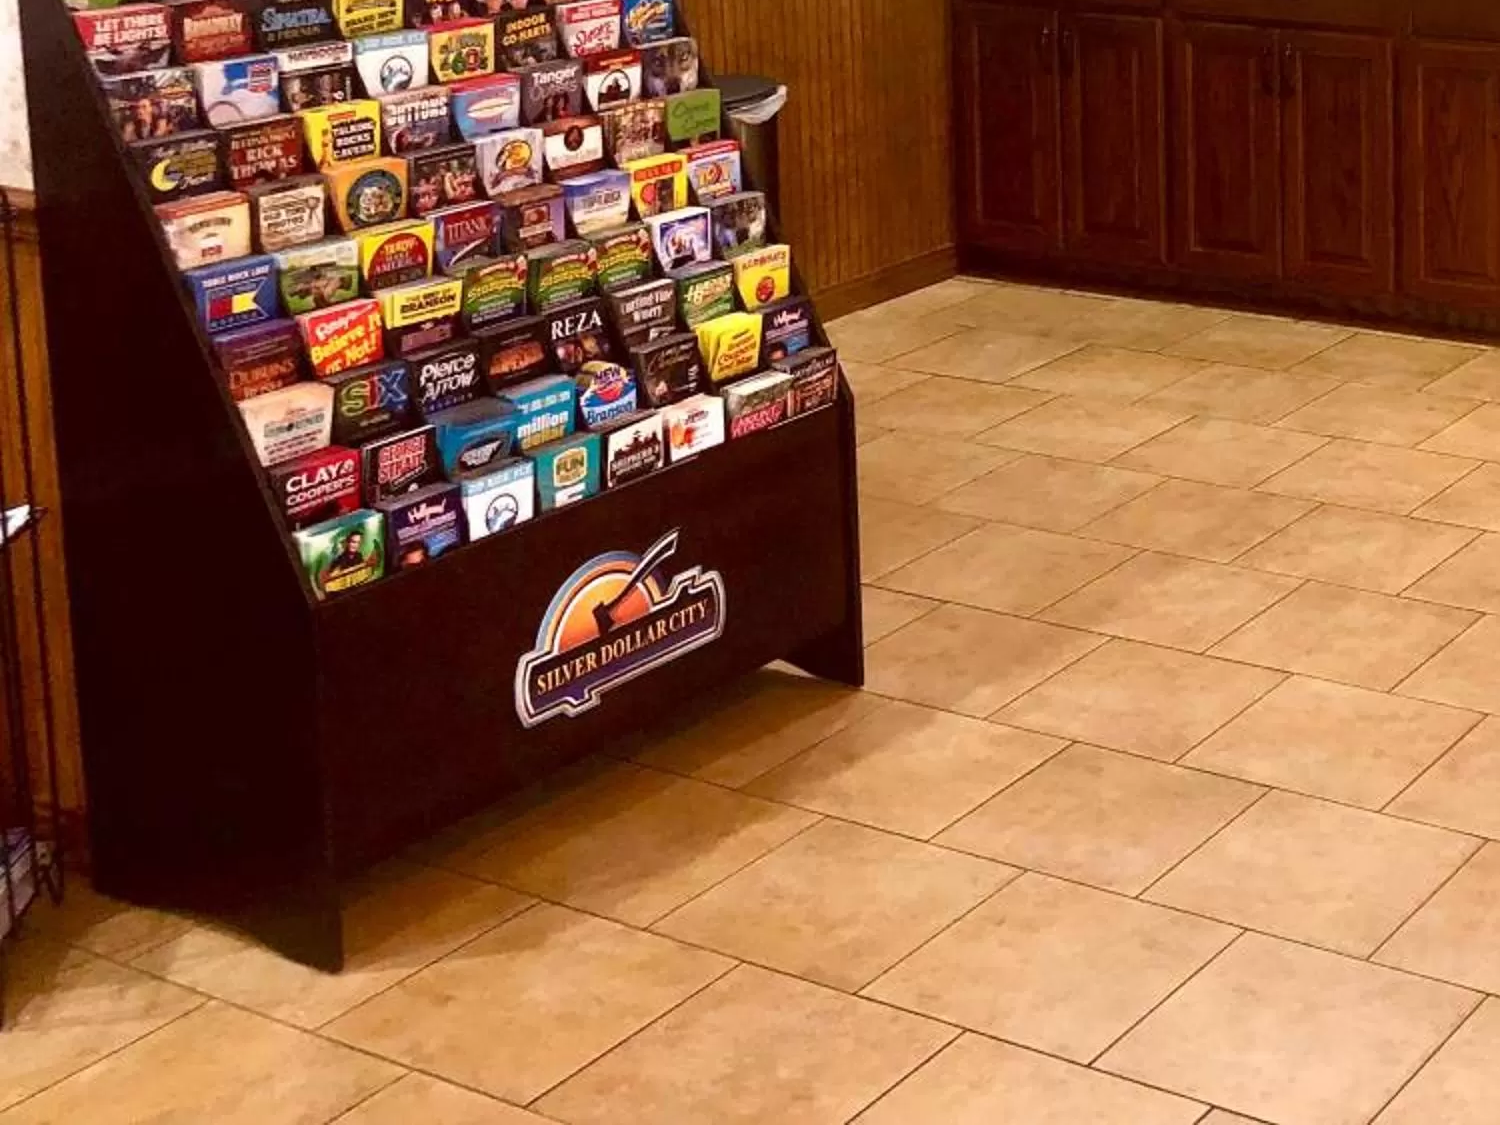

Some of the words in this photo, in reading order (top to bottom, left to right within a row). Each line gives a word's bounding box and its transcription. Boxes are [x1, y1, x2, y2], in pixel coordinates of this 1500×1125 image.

[95, 20, 120, 34] LET
[124, 13, 165, 27] THERE
[506, 12, 547, 33] INDOOR
[93, 31, 114, 46] BE
[532, 66, 577, 85] Tanger
[246, 144, 284, 161] RICK
[400, 294, 456, 314] BRANSON
[551, 309, 603, 341] REZA
[311, 324, 366, 366] Believe
[345, 332, 377, 367] Not!
[597, 366, 622, 382] NEW
[340, 367, 408, 418] SIX
[586, 400, 634, 424] Branson
[518, 411, 569, 439] million
[286, 462, 341, 493] CLAY
[557, 455, 586, 477] FUN
[286, 475, 356, 507] COOPER'S
[536, 654, 598, 696] SILVER
[600, 622, 667, 664] DOLLAR
[669, 599, 708, 633] CITY
